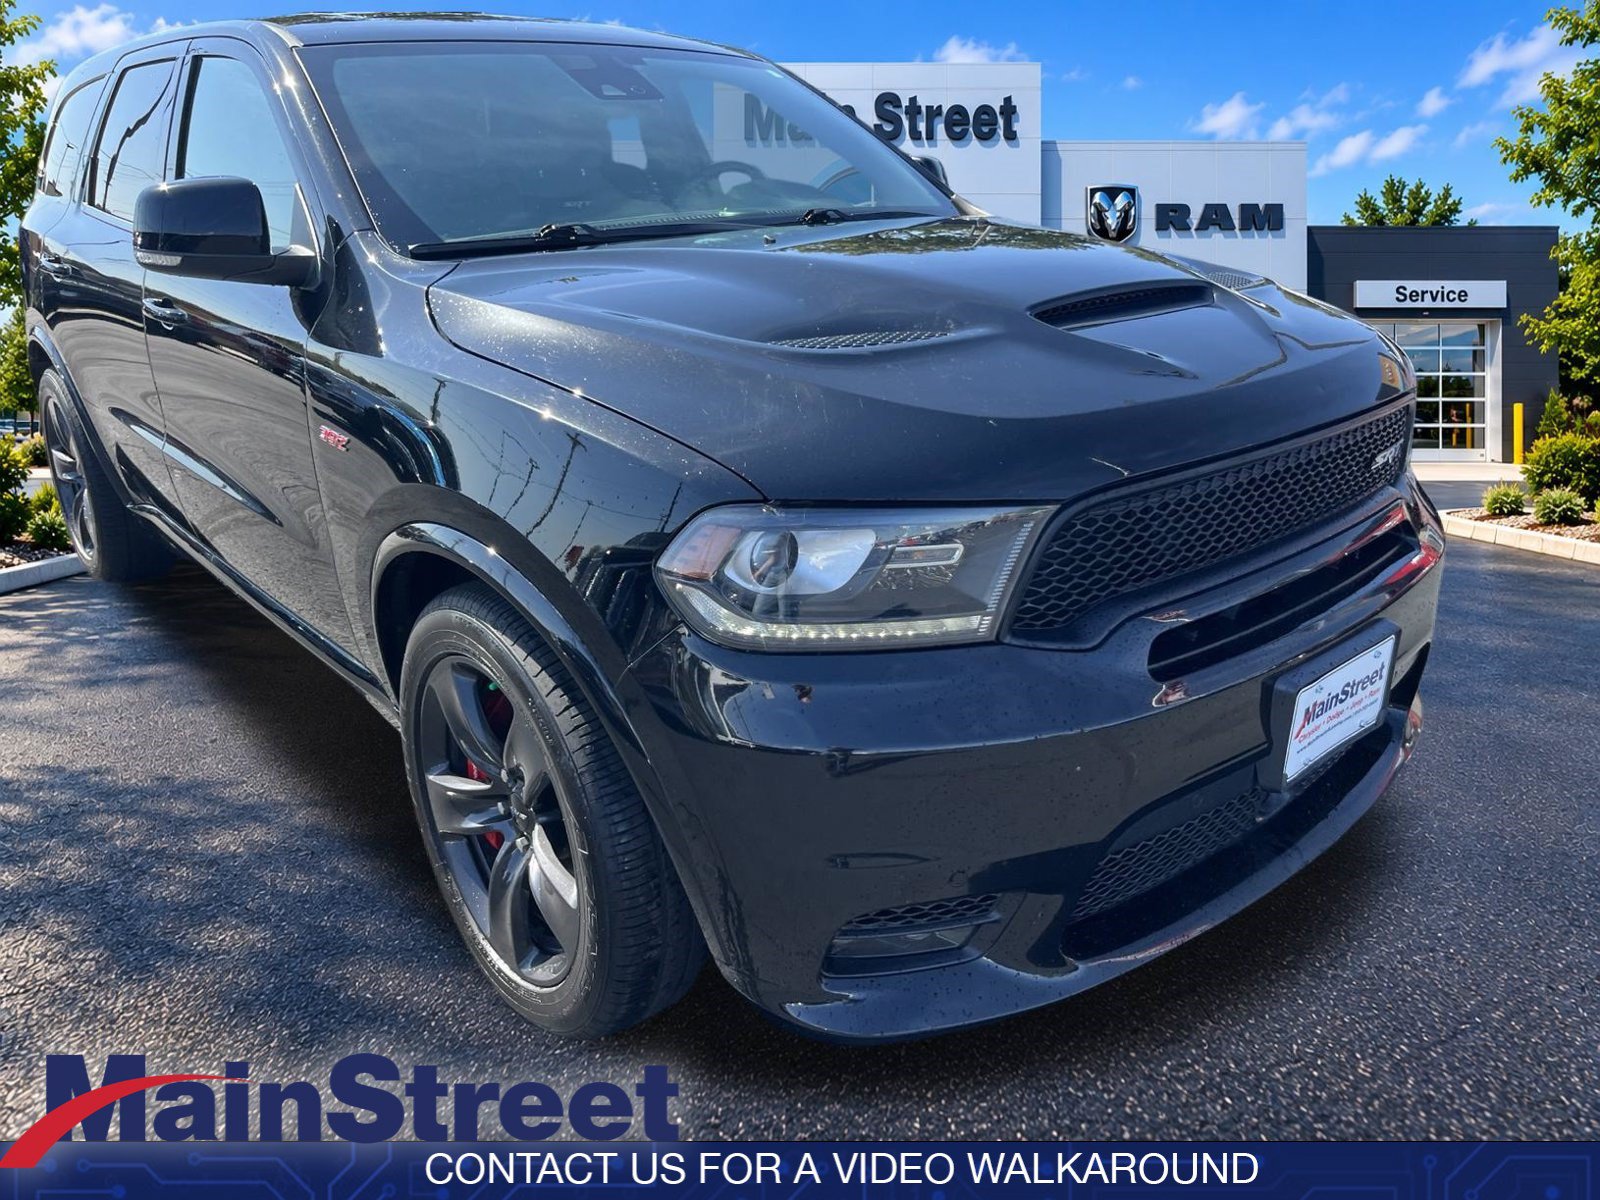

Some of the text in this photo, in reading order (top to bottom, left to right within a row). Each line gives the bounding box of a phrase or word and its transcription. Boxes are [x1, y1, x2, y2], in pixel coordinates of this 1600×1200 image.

[873, 91, 1017, 141] Street
[1155, 202, 1284, 232] RAM
[1394, 285, 1469, 303] Service
[1304, 662, 1385, 726] MainStreet
